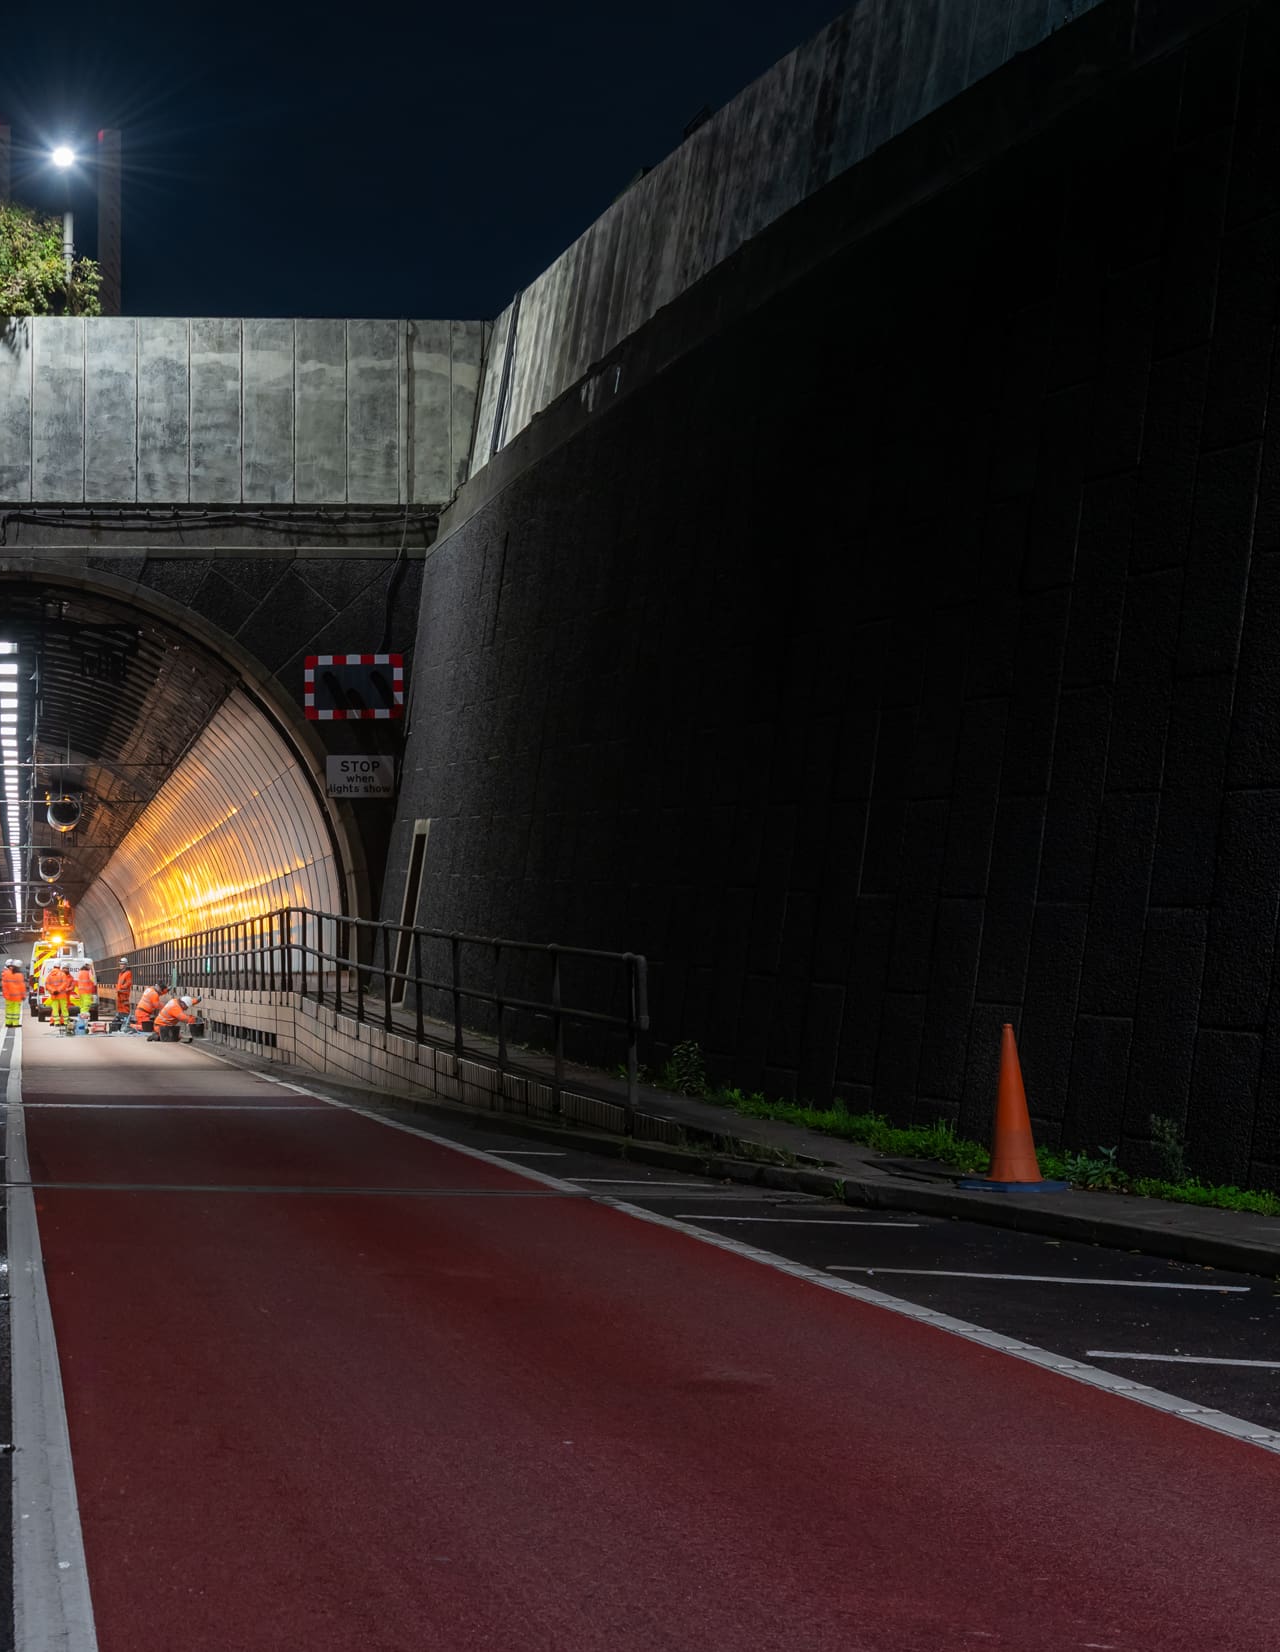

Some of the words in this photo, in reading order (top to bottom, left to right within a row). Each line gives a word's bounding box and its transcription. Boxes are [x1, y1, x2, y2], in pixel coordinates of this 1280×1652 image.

[341, 761, 380, 772] STOP
[347, 774, 374, 783] when
[329, 784, 360, 794] lights
[363, 784, 390, 793] show
